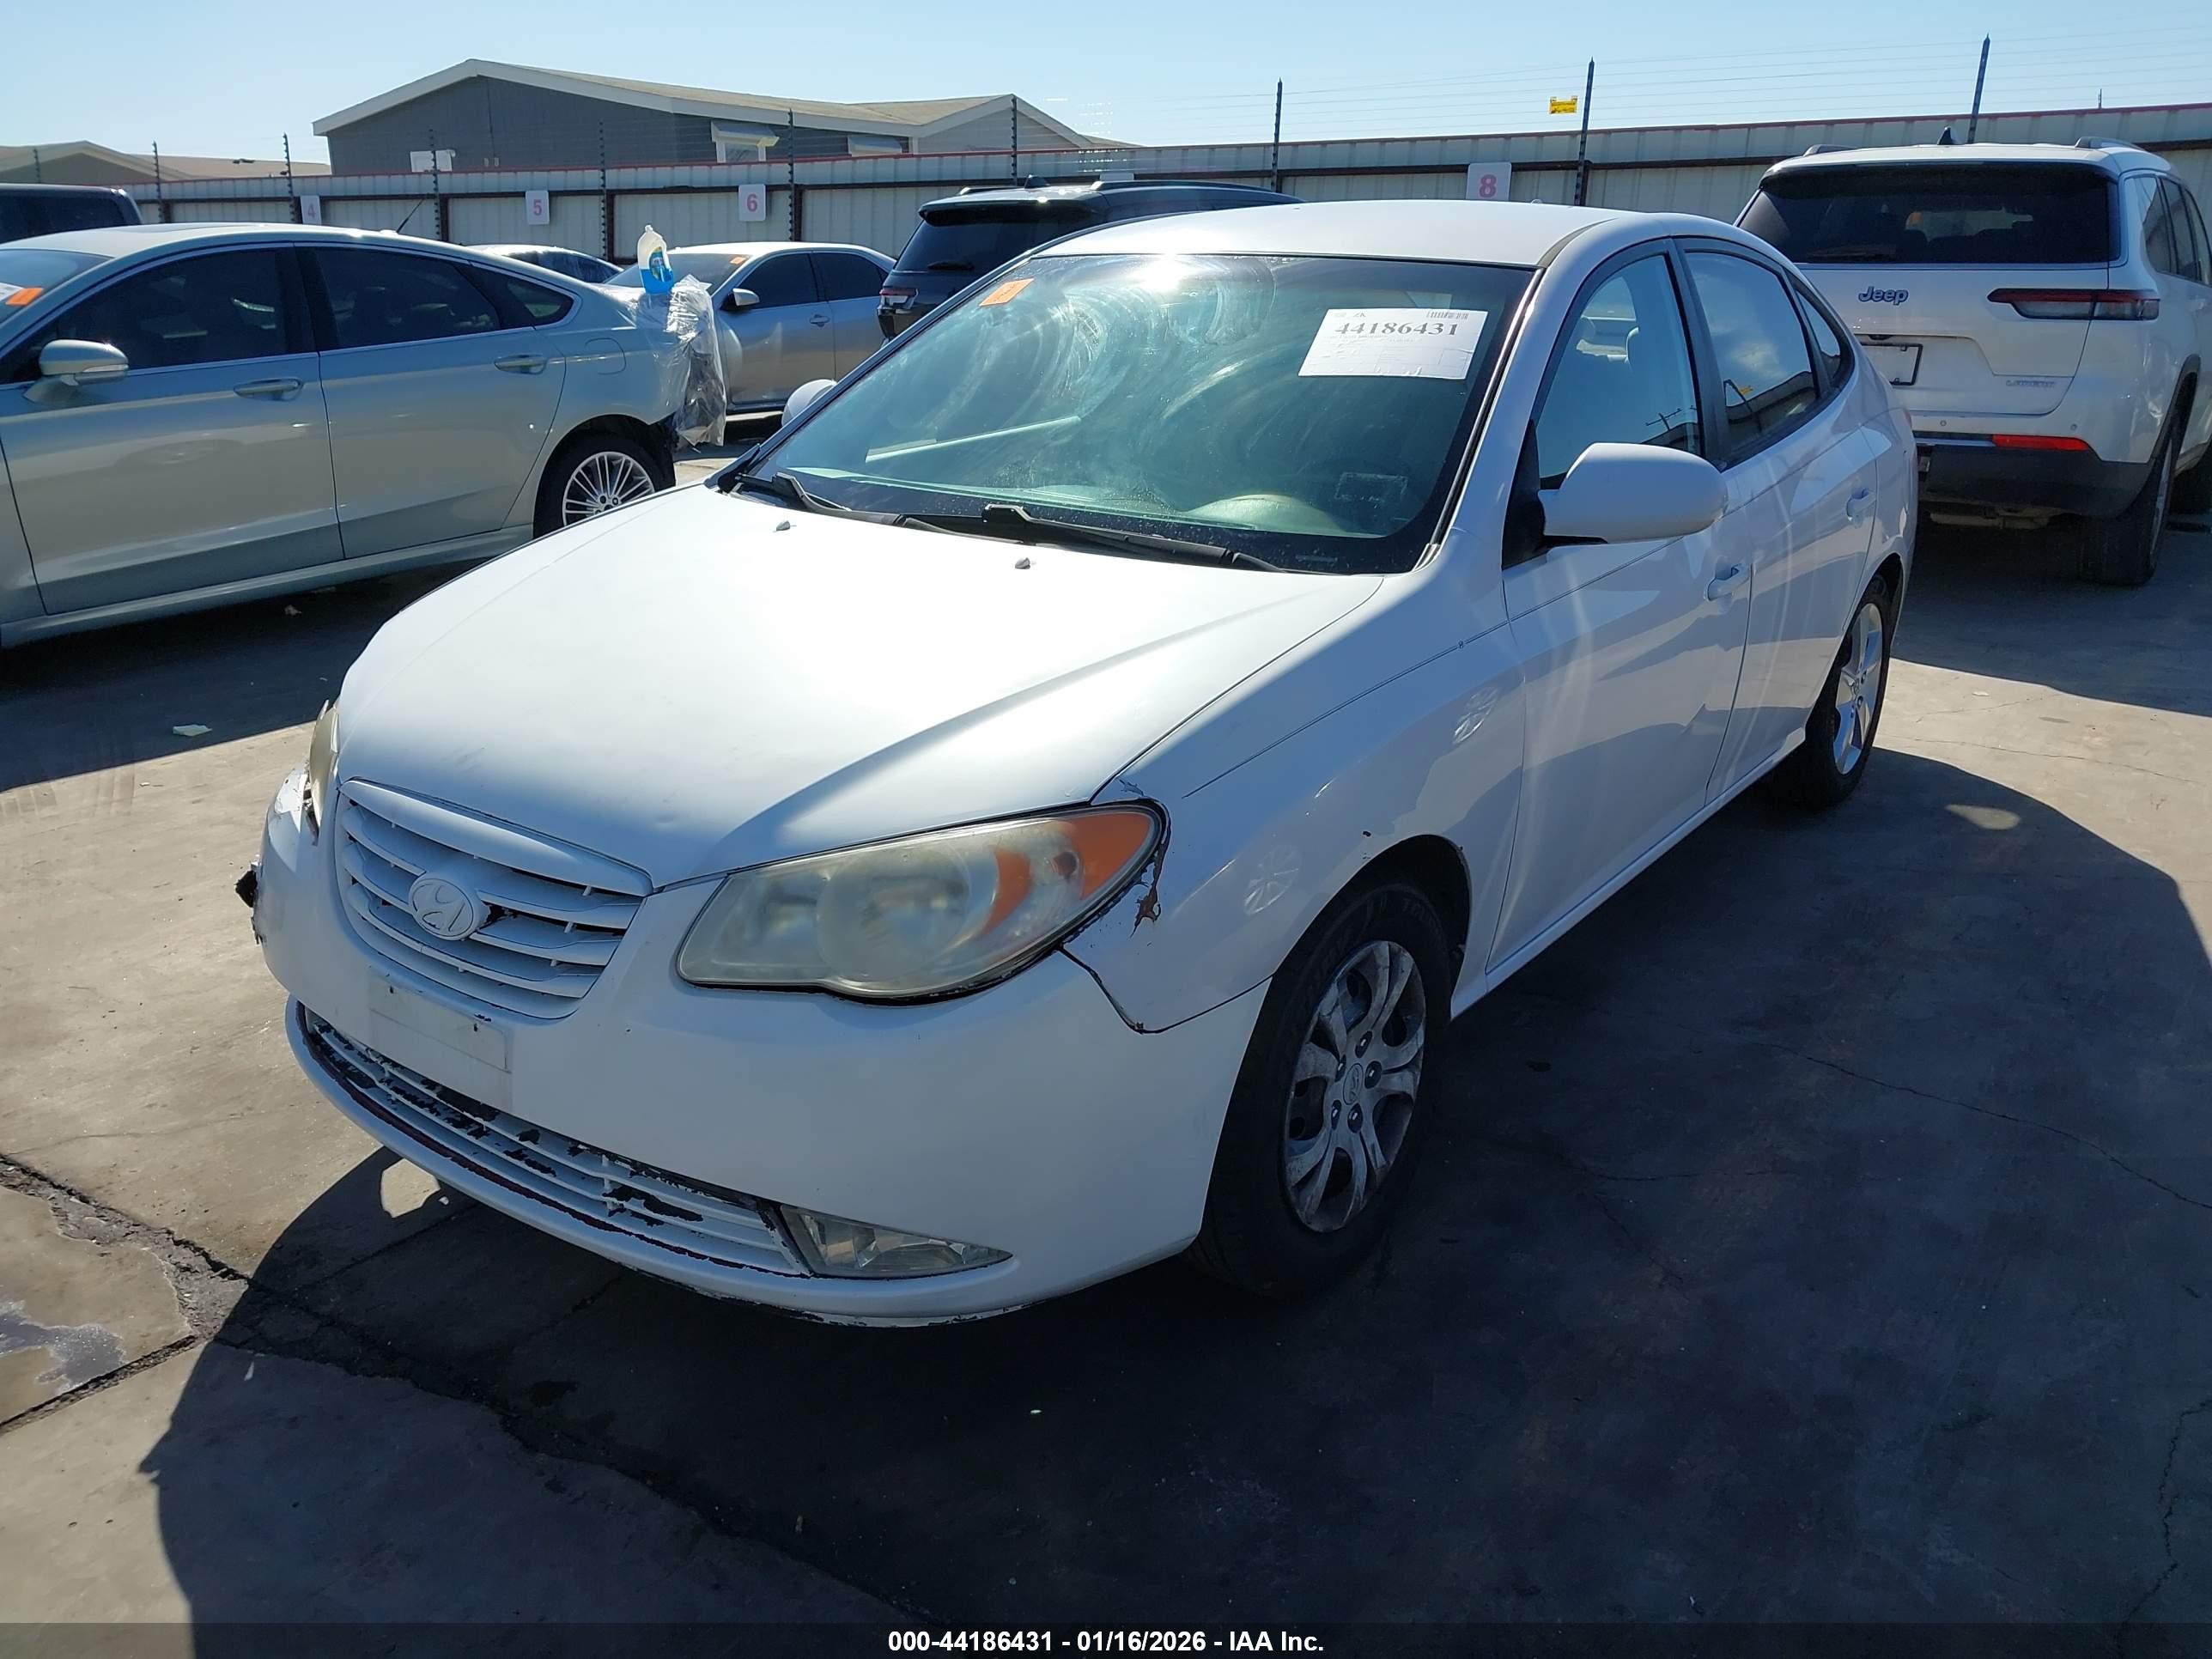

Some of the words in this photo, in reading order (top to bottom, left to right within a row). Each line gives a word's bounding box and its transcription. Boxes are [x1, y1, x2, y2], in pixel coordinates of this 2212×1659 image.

[1480, 174, 1497, 198] 8
[308, 203, 317, 218] 4
[533, 199, 542, 216] 5
[747, 193, 757, 212] 6
[1858, 286, 1909, 306] Jeep
[1334, 322, 1458, 336] 44186431
